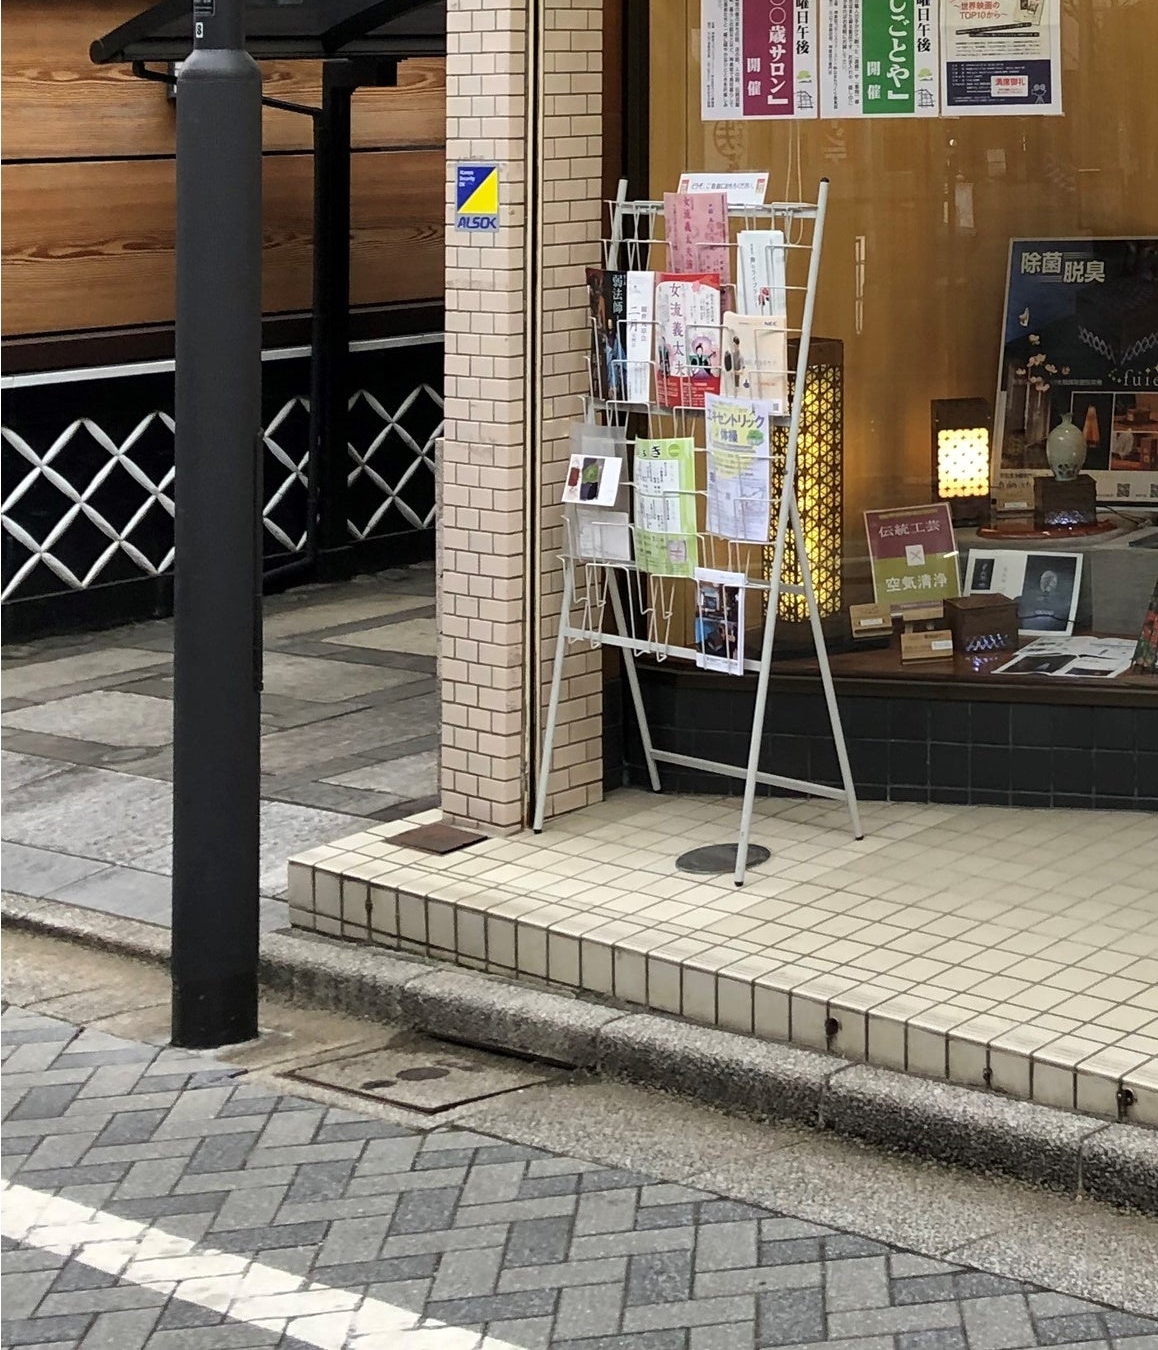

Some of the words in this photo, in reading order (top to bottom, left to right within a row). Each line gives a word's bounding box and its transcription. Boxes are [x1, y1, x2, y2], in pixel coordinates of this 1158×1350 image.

[747, 57, 762, 96] 開催
[867, 61, 881, 100] 開催
[457, 216, 497, 229] ALSOK
[1020, 250, 1063, 275] 除菌
[1062, 260, 1106, 284] 脱臭
[669, 282, 685, 376] 女流義太夫
[878, 519, 941, 539] 伝統工芸
[885, 572, 948, 593] 空気清浄
